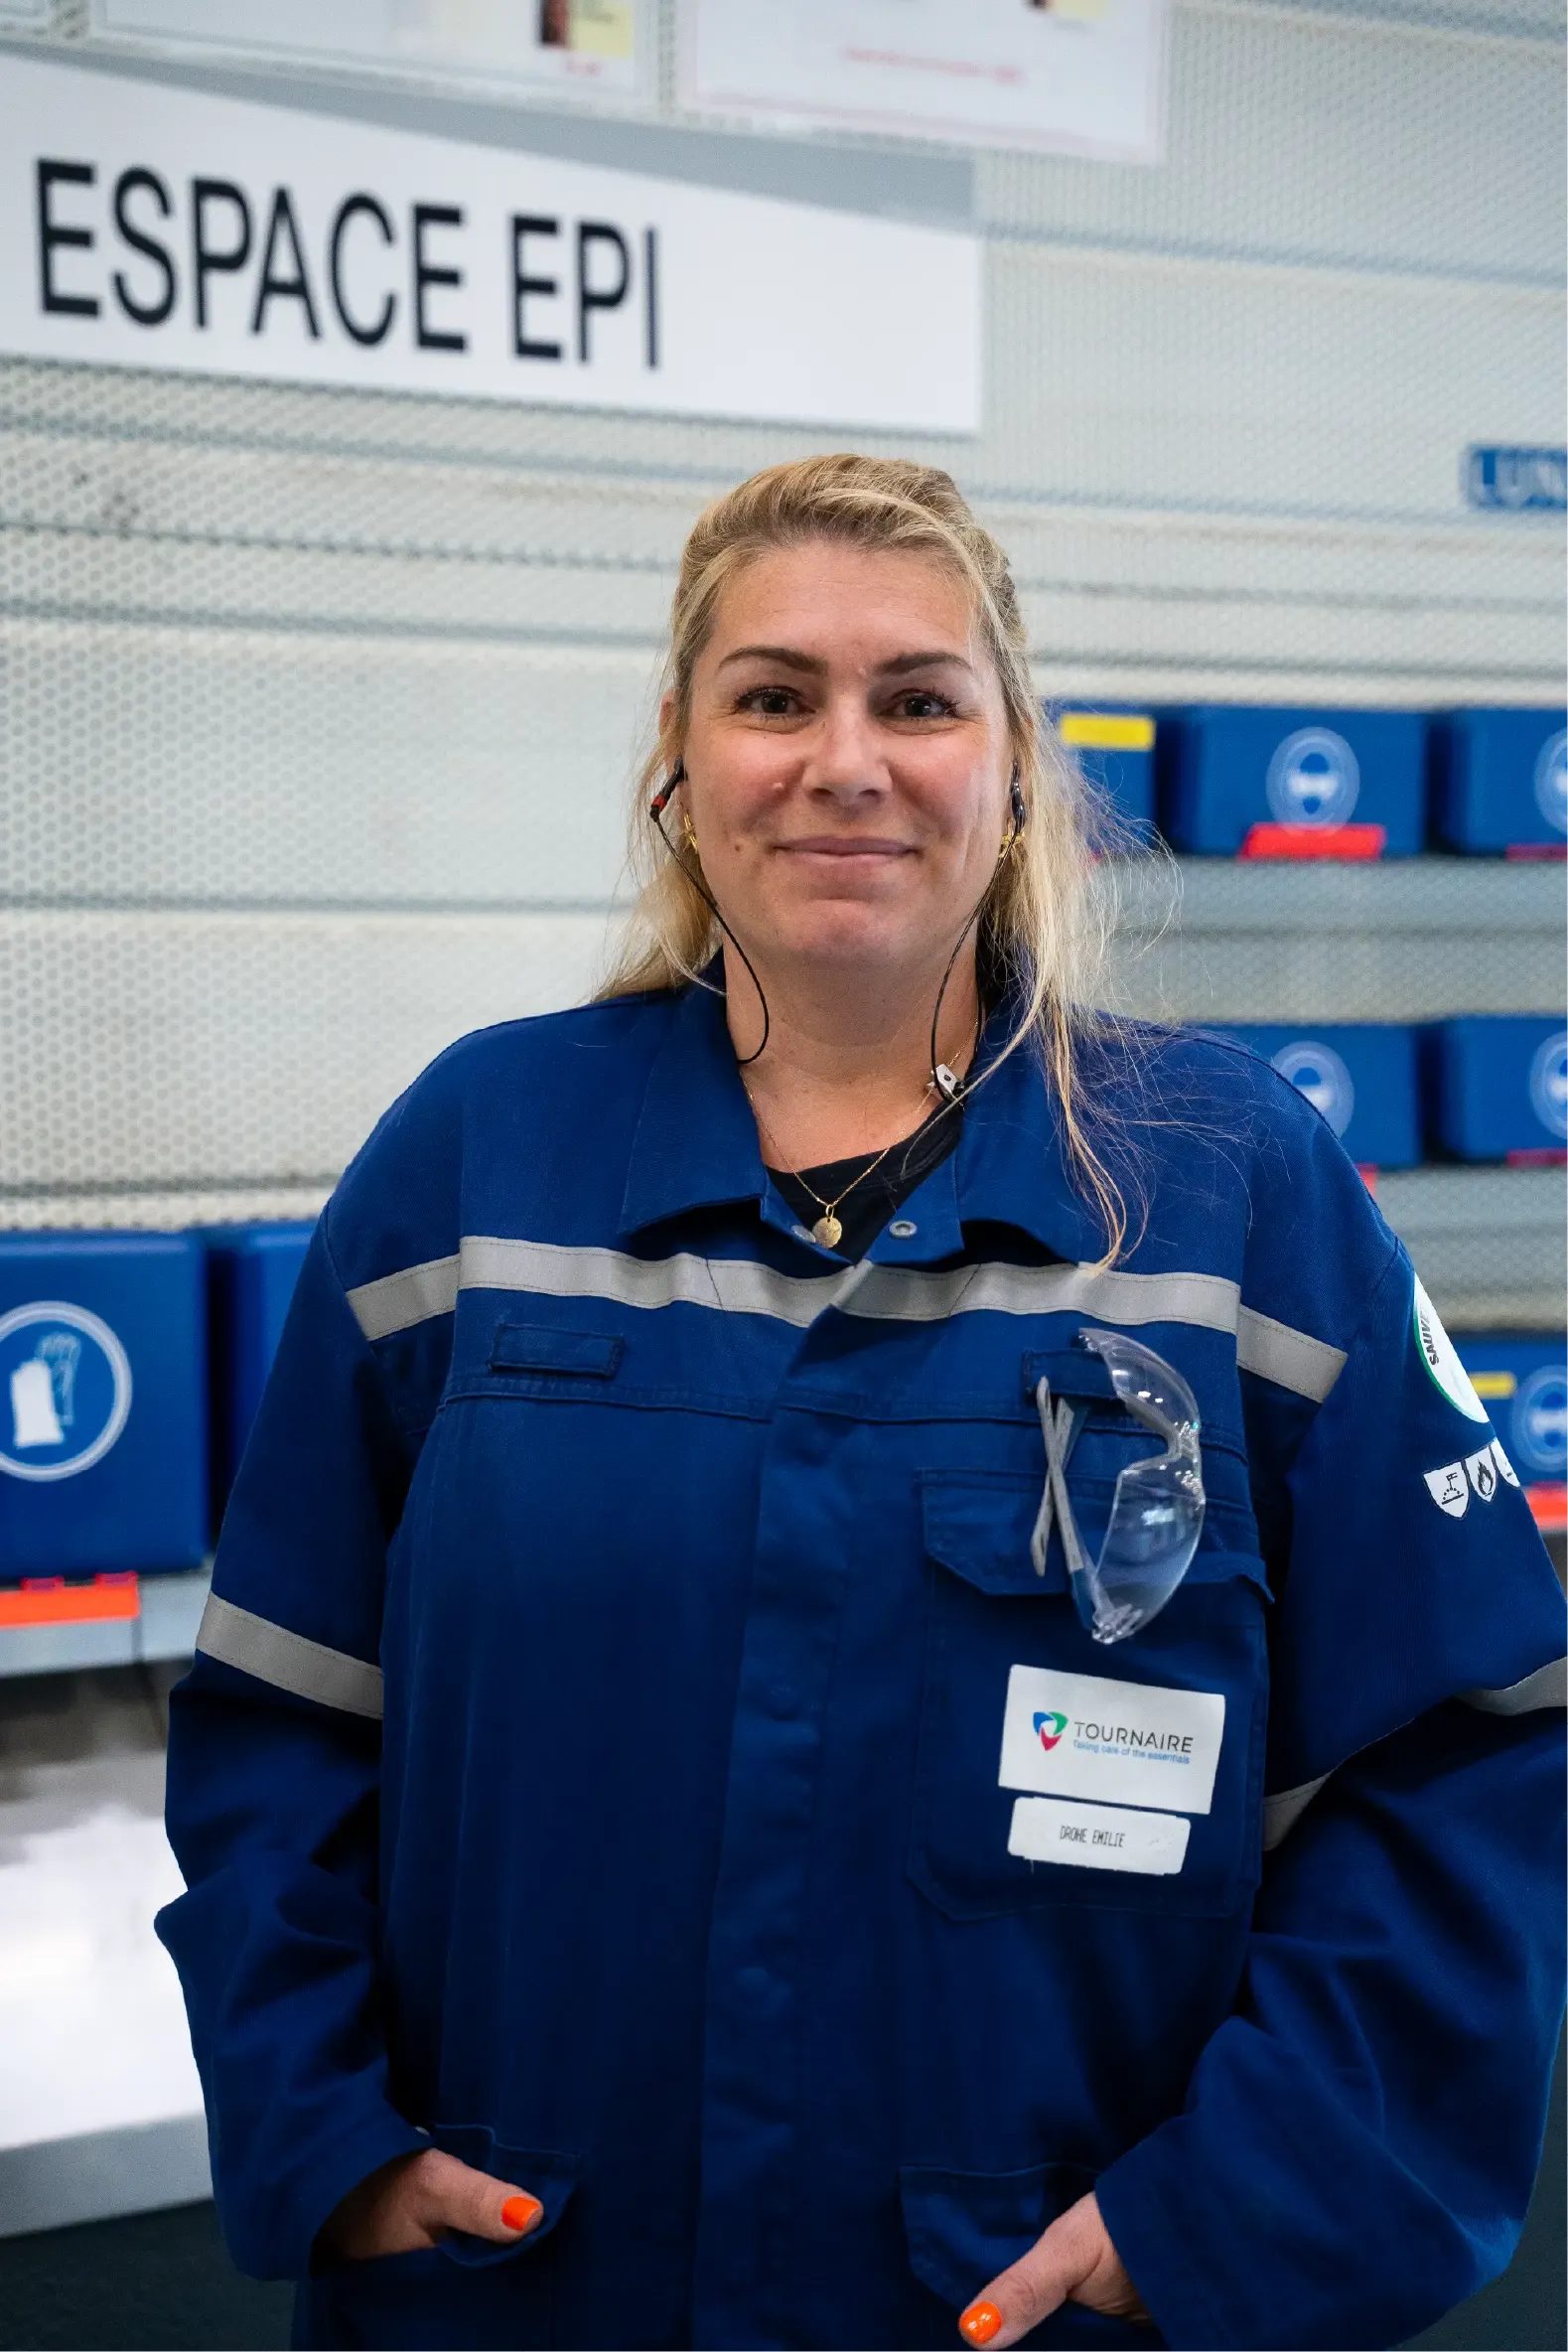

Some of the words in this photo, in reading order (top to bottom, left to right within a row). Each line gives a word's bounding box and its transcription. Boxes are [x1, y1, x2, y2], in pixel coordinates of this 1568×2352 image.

[36, 157, 467, 353] ESPACE
[510, 214, 660, 369] EPI
[1073, 1721, 1194, 1753] TOURNAIRE
[1073, 1739, 1099, 1754] Taking
[1101, 1744, 1119, 1755] care
[1121, 1747, 1131, 1756] of
[1132, 1749, 1146, 1758] the
[1148, 1752, 1191, 1765] essentials
[1092, 1829, 1125, 1848] EMILIE
